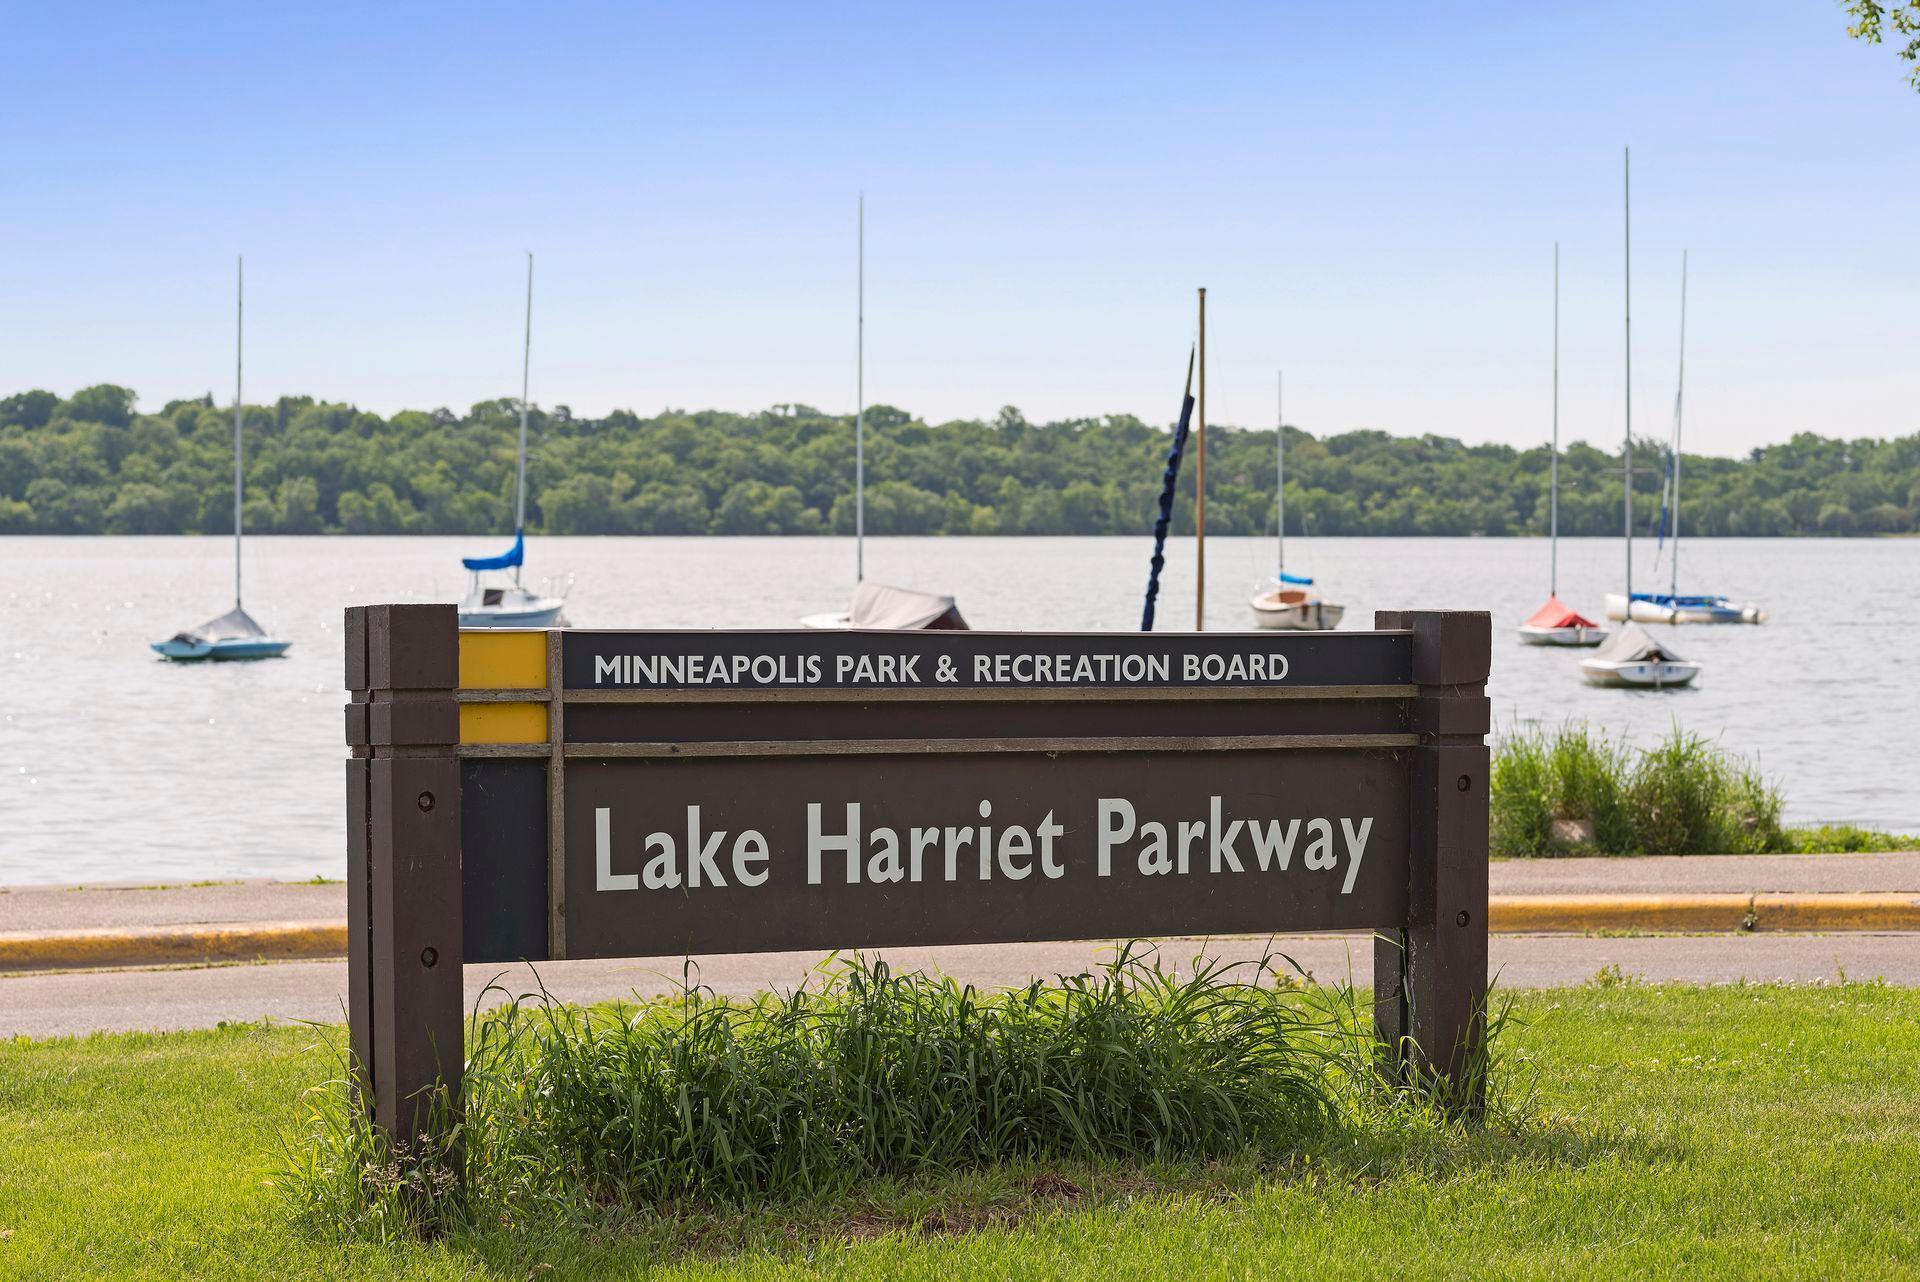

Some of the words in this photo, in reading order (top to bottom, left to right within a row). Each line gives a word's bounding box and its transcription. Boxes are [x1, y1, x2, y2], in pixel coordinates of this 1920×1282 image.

[594, 655, 822, 684] MINNEAPOLIS
[835, 654, 921, 683] PARK
[935, 655, 959, 683] &
[973, 654, 1170, 682] RECREATION
[1183, 654, 1289, 681] BOARD
[595, 805, 770, 892] Lake
[807, 799, 1065, 885] Harriet
[1098, 795, 1374, 894] Parkway
